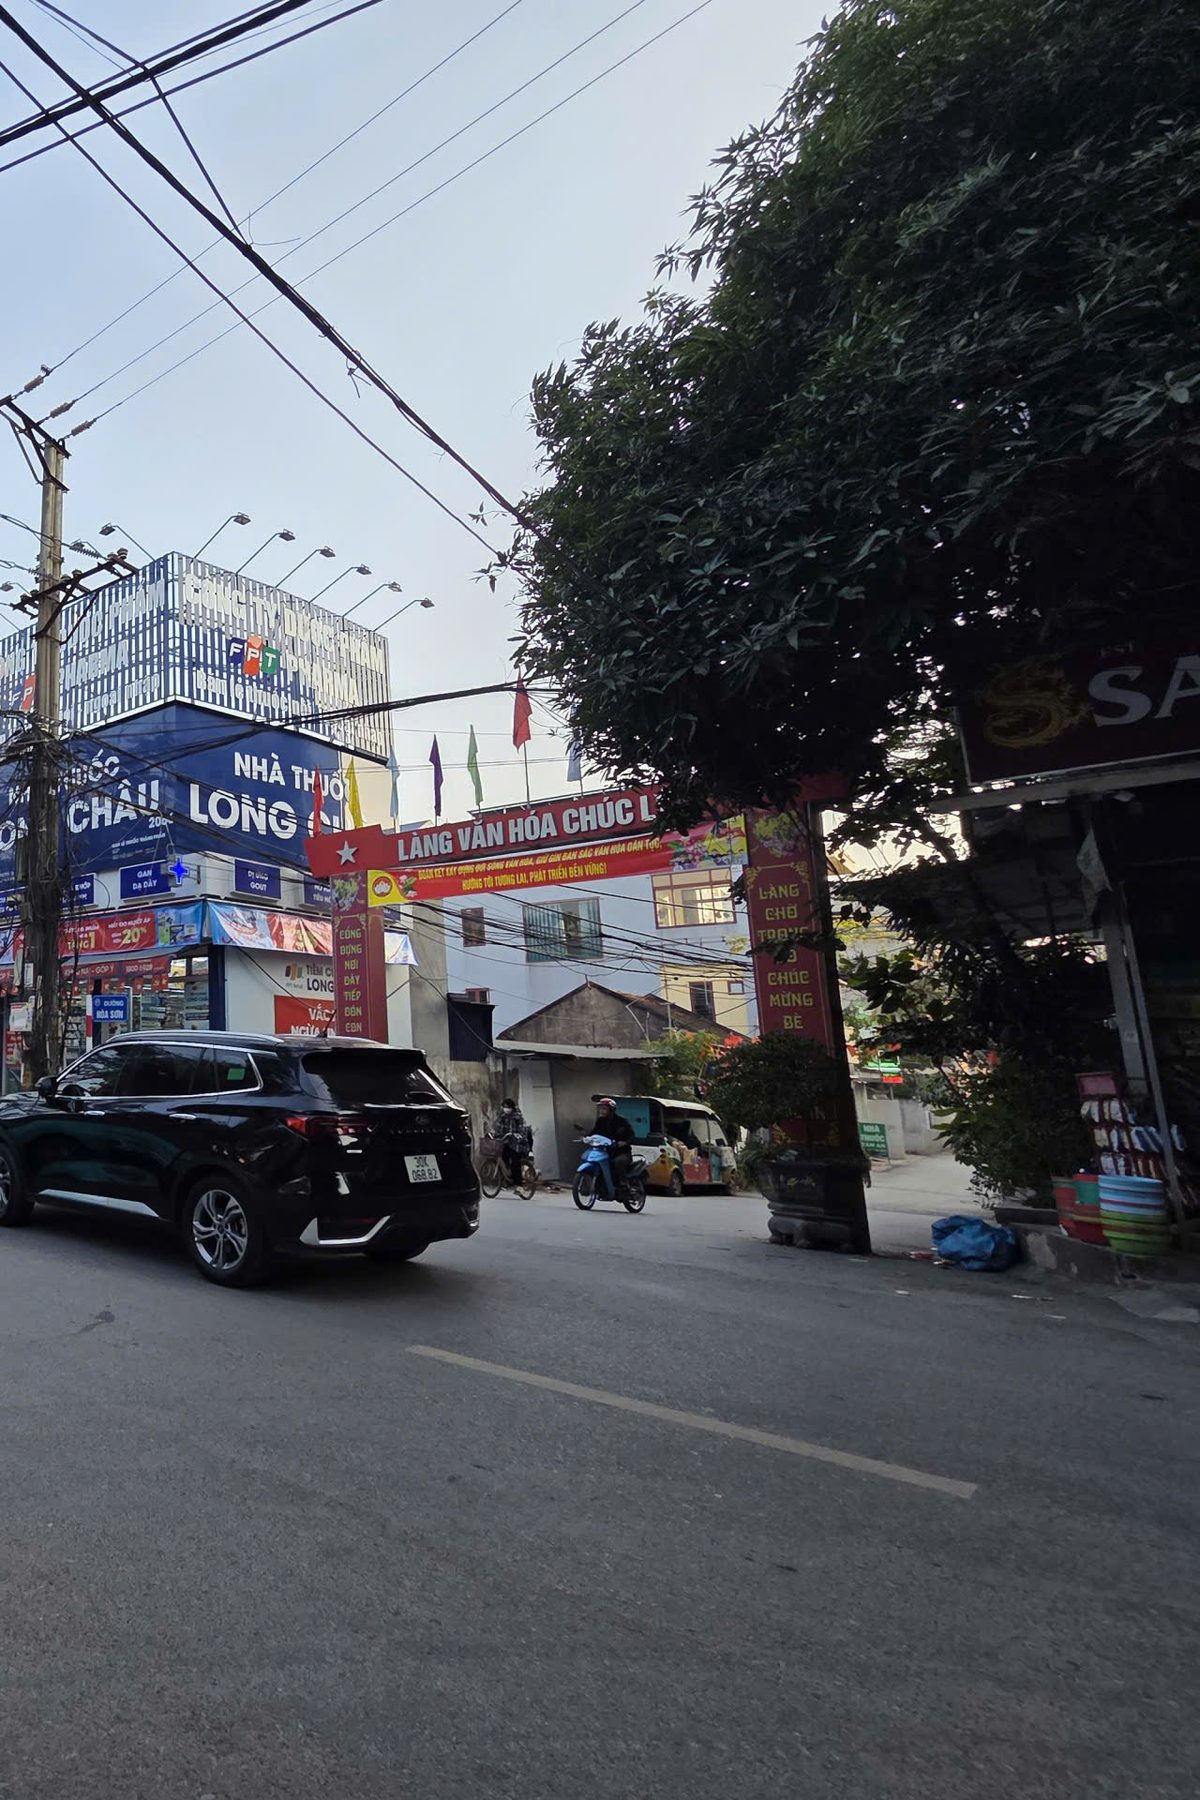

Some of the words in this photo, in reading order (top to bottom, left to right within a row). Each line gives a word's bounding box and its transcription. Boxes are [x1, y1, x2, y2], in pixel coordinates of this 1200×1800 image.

[252, 596, 279, 629] TY
[228, 637, 279, 673] FPT
[286, 650, 360, 711] PHARMA
[234, 752, 286, 786] NHÀ
[68, 779, 161, 834] CHÂU
[189, 783, 298, 840] LONG
[398, 831, 453, 862] LÀNG
[457, 818, 504, 851] VĂN
[508, 809, 557, 844] HÓA
[562, 796, 634, 835] CHÚC
[759, 883, 799, 900] LÀNG
[307, 978, 334, 993] LONG
[768, 968, 810, 986] CHÚC
[110, 1008, 124, 1019] SƠN
[769, 991, 814, 1008] MỪNG
